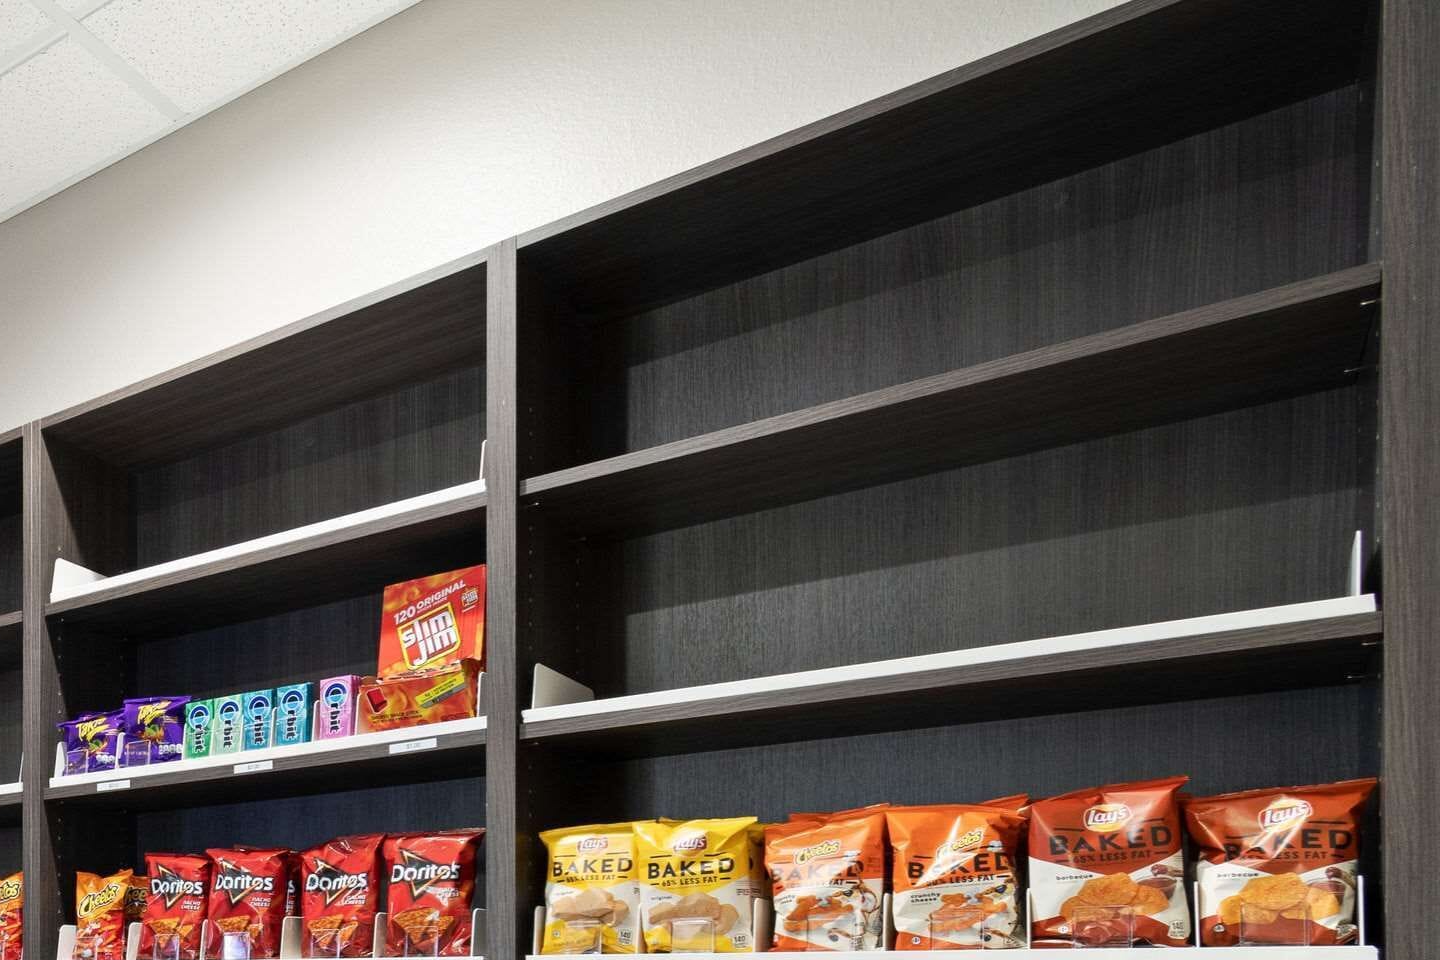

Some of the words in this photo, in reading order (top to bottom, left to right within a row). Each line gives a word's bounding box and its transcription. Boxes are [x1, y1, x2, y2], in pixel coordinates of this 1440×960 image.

[393, 605, 417, 625] 120
[416, 579, 466, 610] ORIGINAL
[1049, 825, 1172, 855] BAKED
[795, 841, 841, 864] Cheetos
[1100, 853, 1128, 862] LESS
[1131, 850, 1152, 859] FAT
[1304, 850, 1328, 859] FAT
[391, 862, 460, 883] Doritos
[553, 857, 633, 877] BAKED
[647, 858, 735, 879] BAKED
[151, 879, 203, 895] Doritos
[215, 874, 274, 891] Doritos
[305, 873, 368, 891] Doritos
[679, 878, 700, 886] LESS
[702, 876, 718, 884] FAT
[950, 875, 974, 884] LESS
